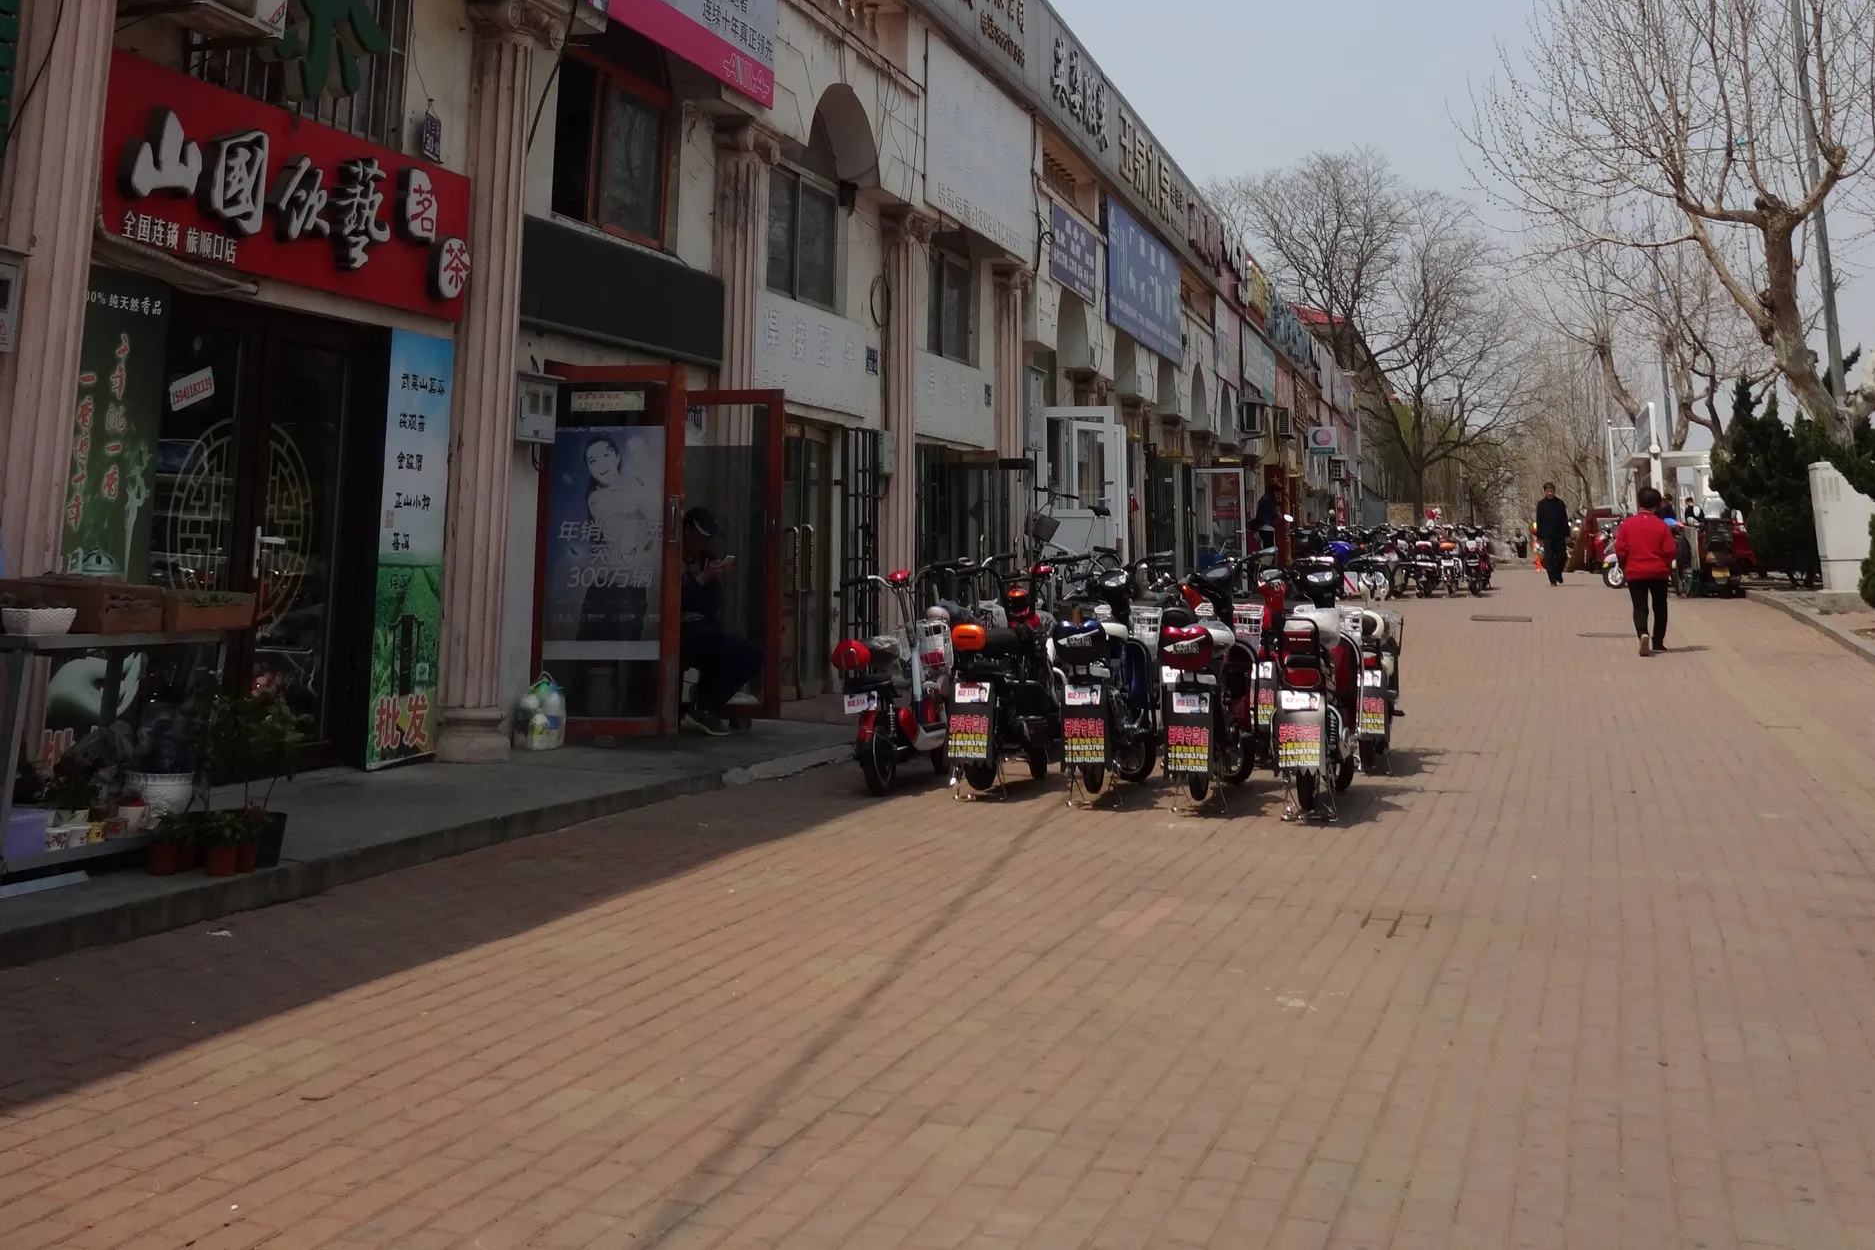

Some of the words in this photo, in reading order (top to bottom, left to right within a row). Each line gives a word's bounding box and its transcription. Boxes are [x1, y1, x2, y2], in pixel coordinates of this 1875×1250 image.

[121, 210, 179, 253] 全国连锁
[184, 224, 238, 264] 旅顺口店
[109, 293, 163, 316] 纯天然香品
[567, 566, 655, 589] 300万辆
[375, 694, 429, 751] 批发
